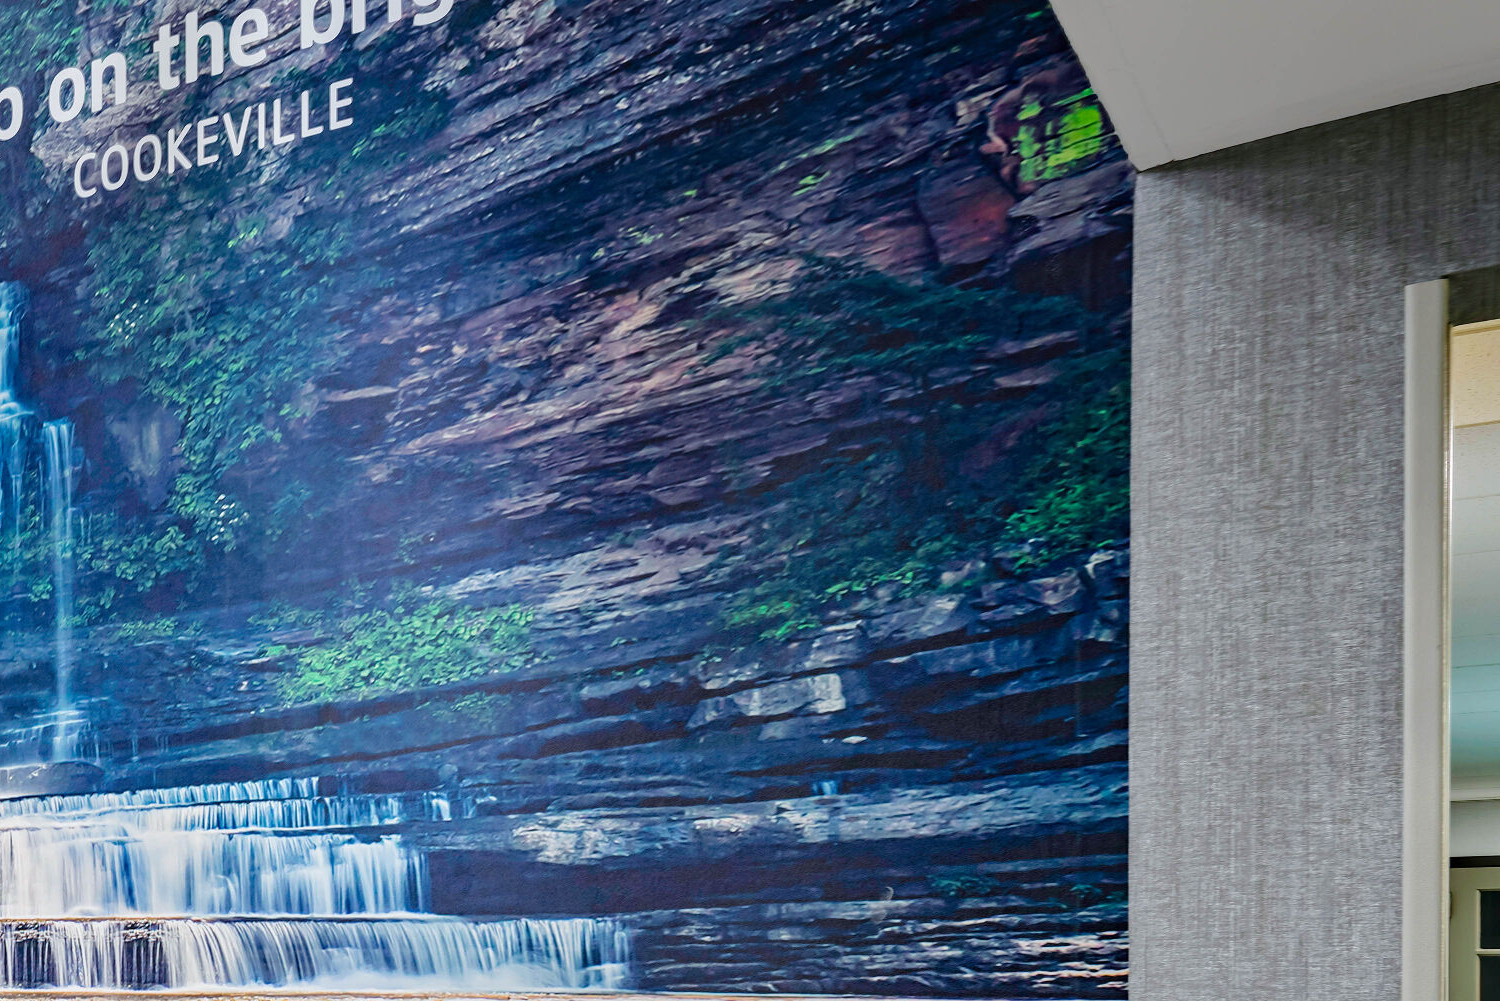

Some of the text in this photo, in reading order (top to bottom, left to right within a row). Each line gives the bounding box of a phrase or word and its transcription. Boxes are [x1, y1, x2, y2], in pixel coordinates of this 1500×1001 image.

[48, 51, 128, 123] on
[153, 7, 269, 91] the
[72, 77, 355, 199] COOKEVILLE
